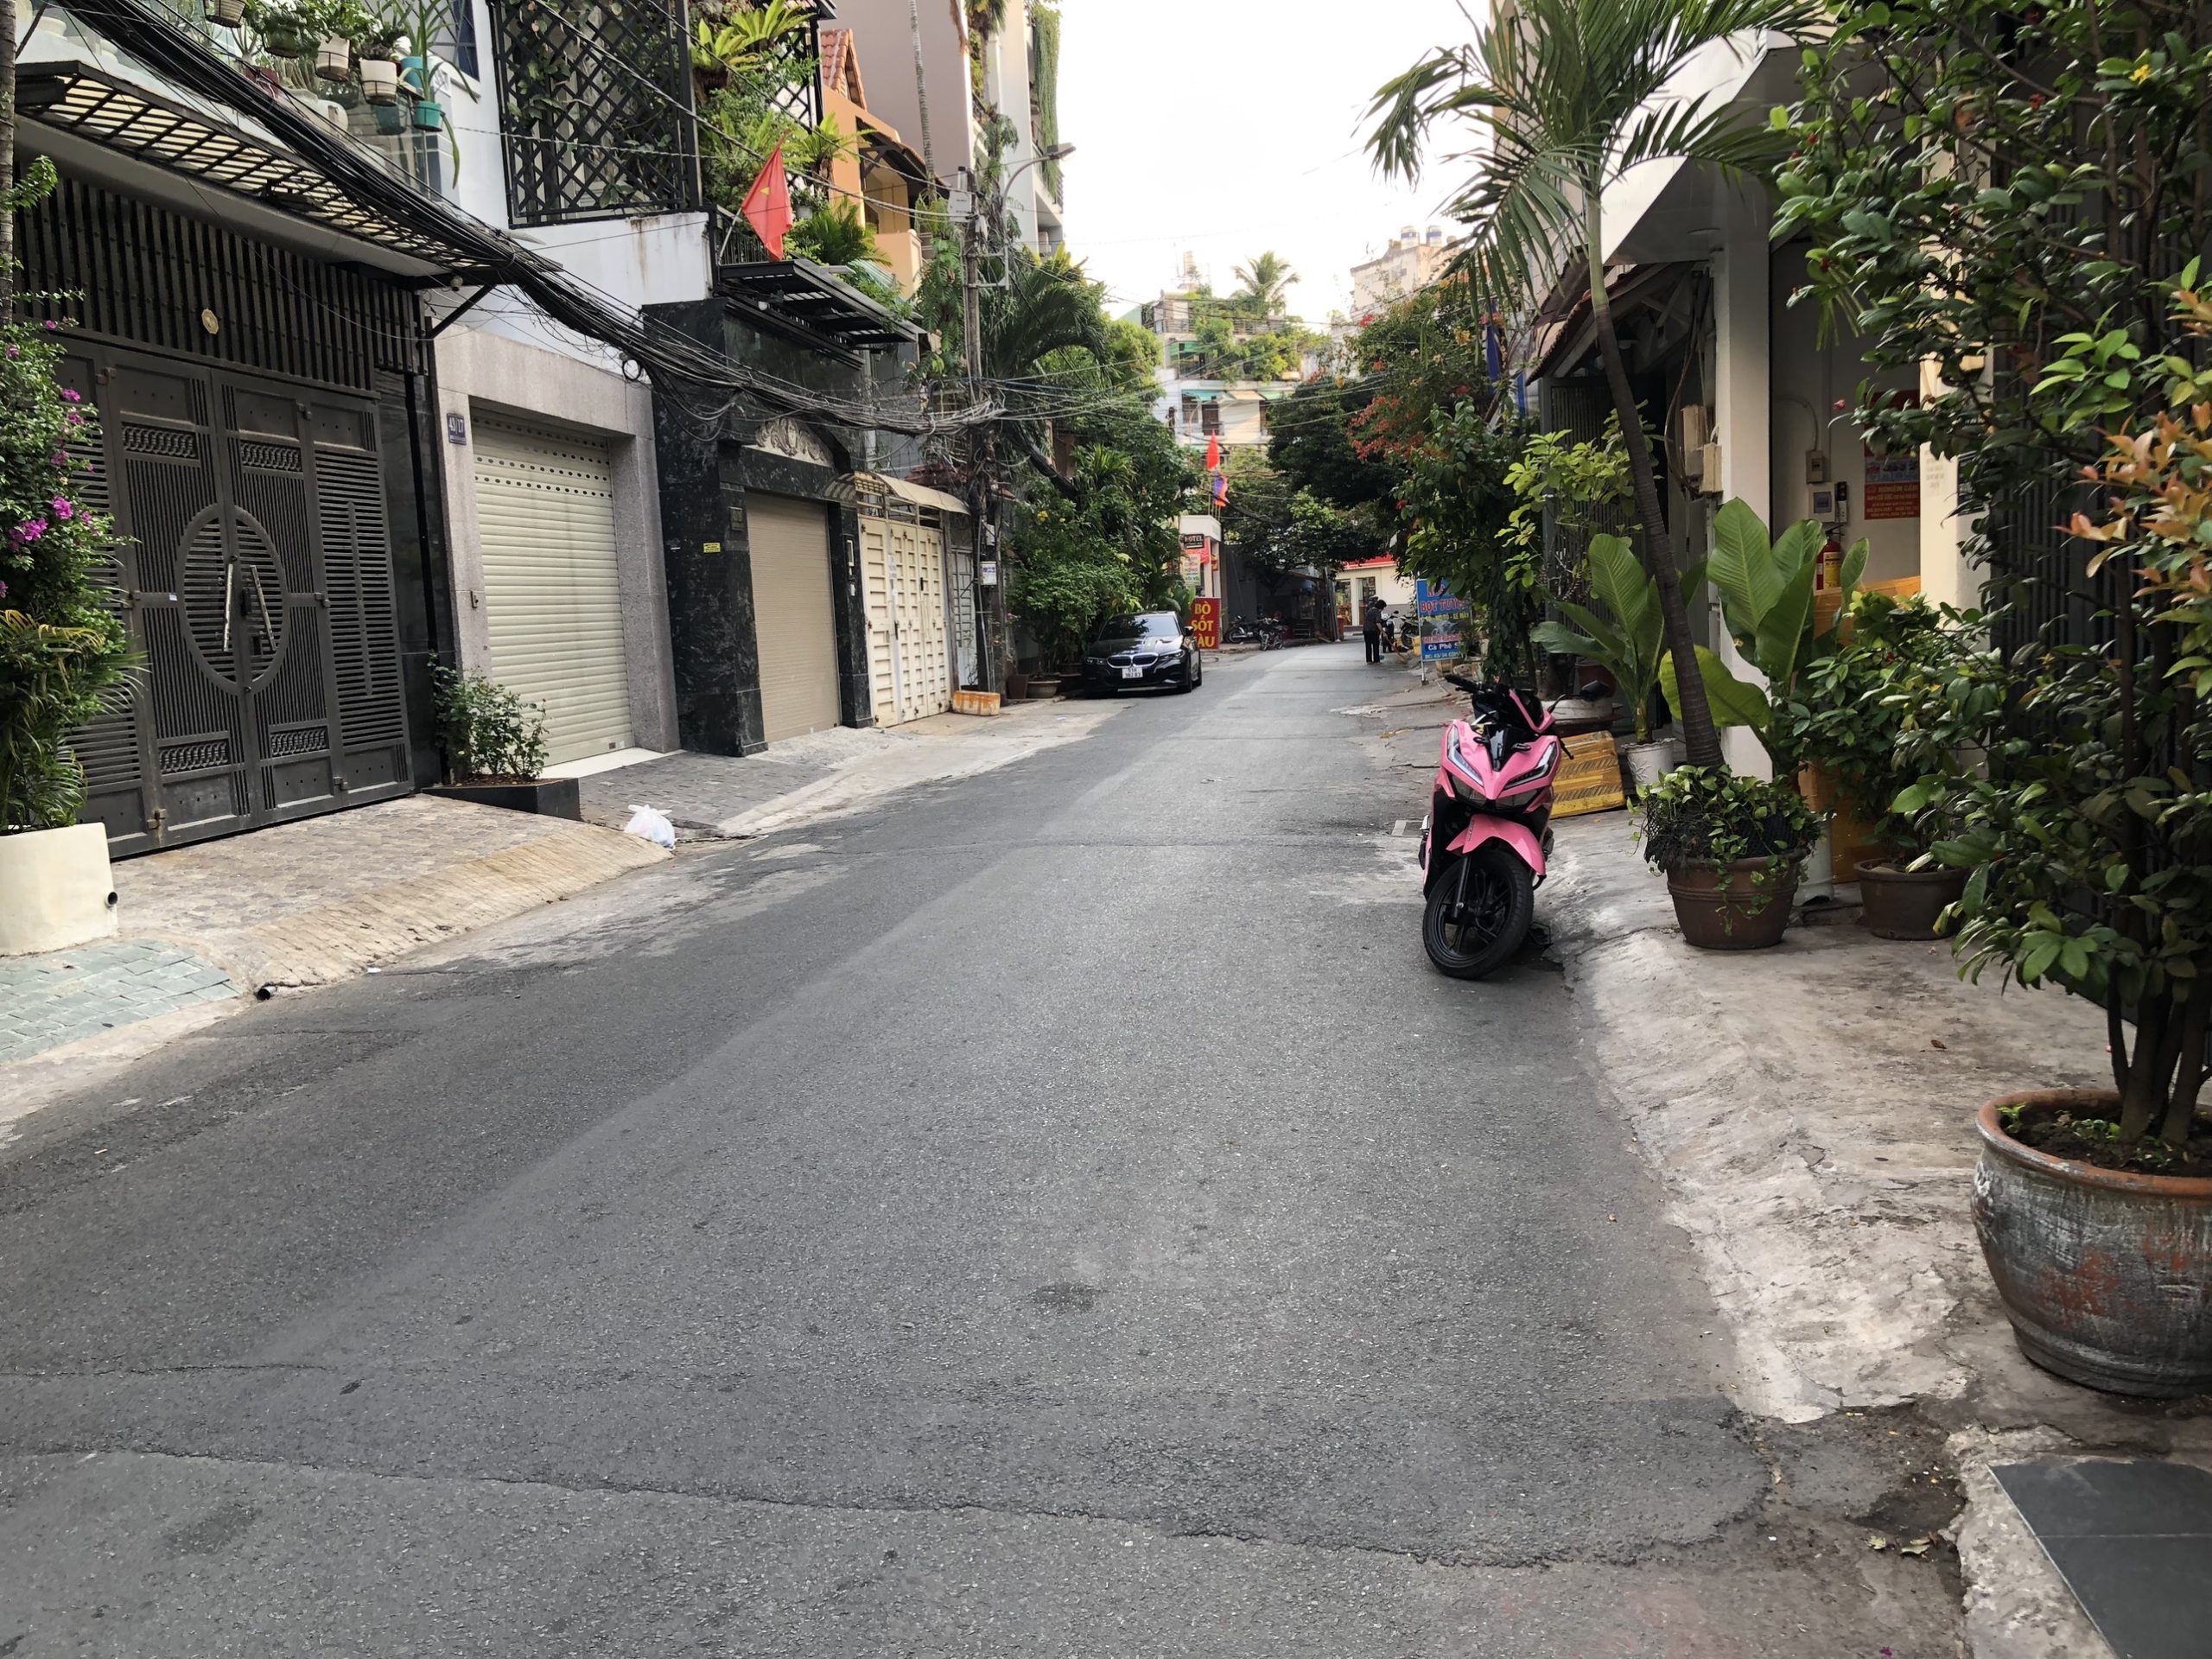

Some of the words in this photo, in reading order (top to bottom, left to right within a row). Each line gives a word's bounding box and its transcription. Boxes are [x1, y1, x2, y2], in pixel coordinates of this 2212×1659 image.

[449, 416, 464, 435] 43/17
[1194, 601, 1211, 615] BÒ
[1191, 614, 1215, 632] SỐT
[1196, 633, 1216, 647] ÀU
